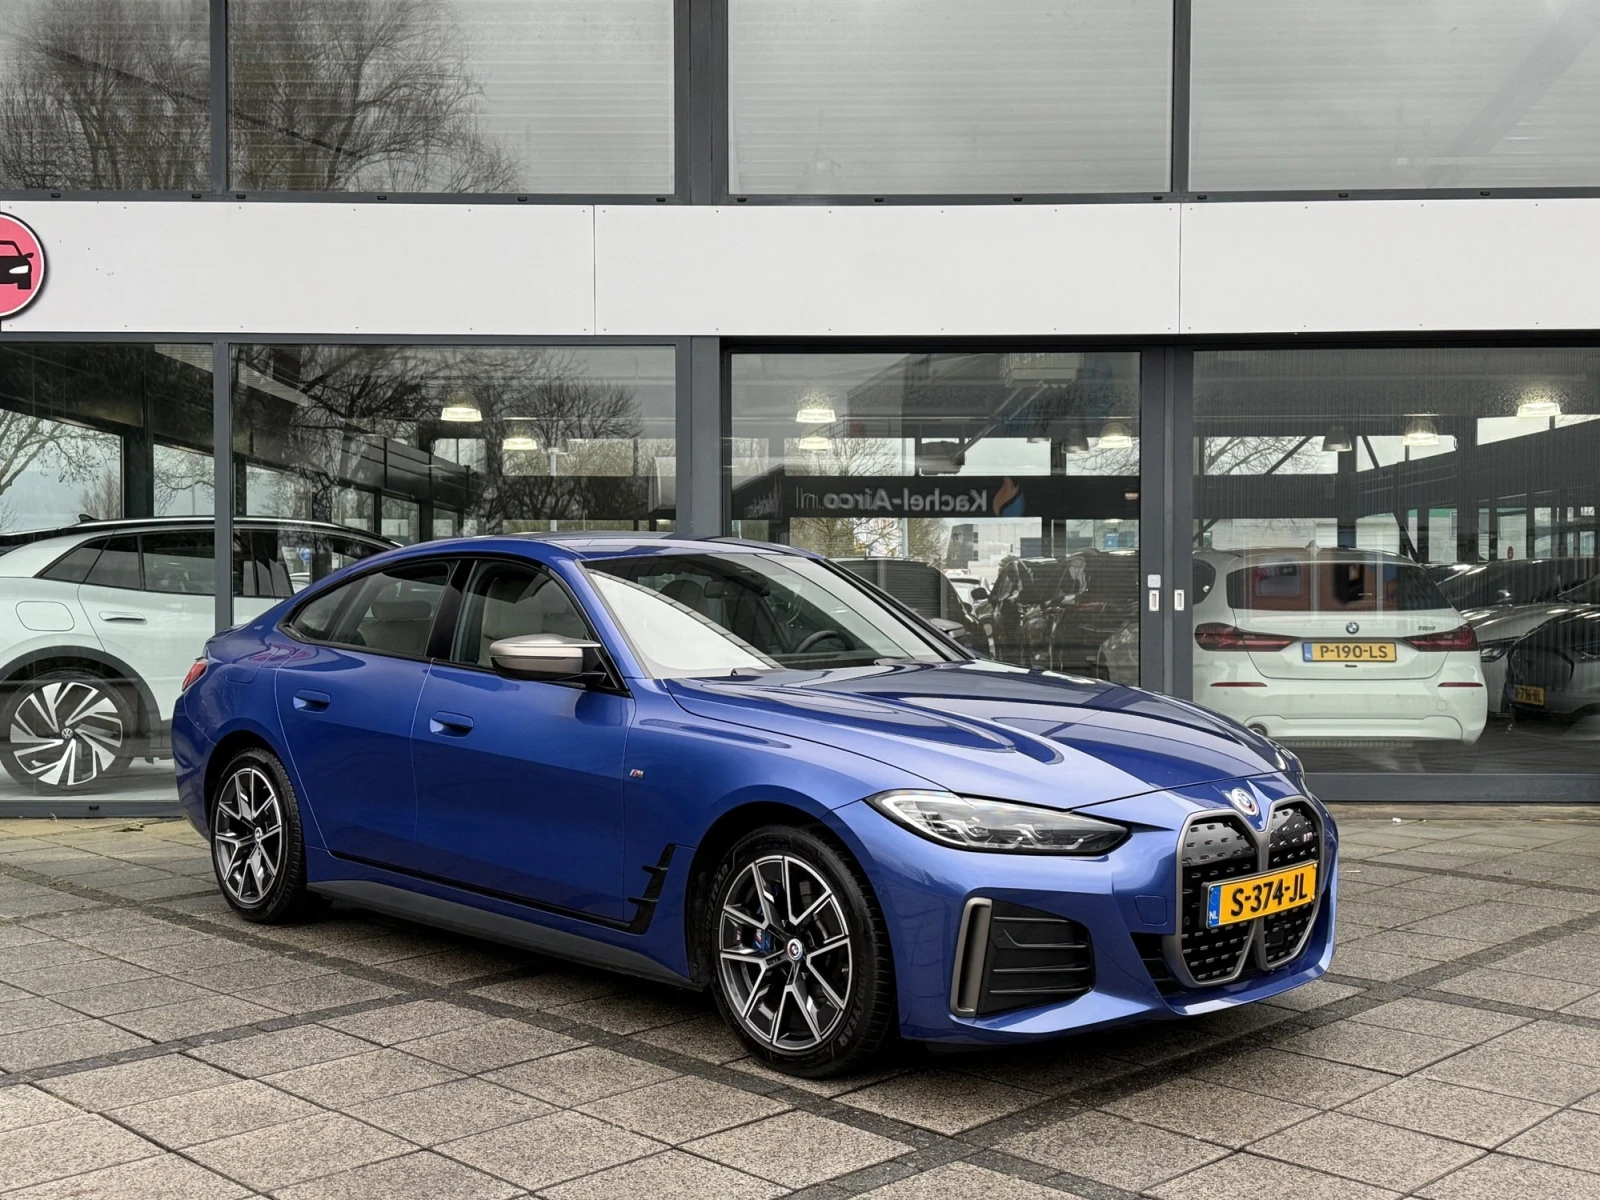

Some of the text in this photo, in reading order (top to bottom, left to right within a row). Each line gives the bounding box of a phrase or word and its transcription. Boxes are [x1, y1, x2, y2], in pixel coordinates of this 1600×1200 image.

[1319, 645, 1388, 659] P-190-LS
[1209, 872, 1308, 920] NL S-374-JL
